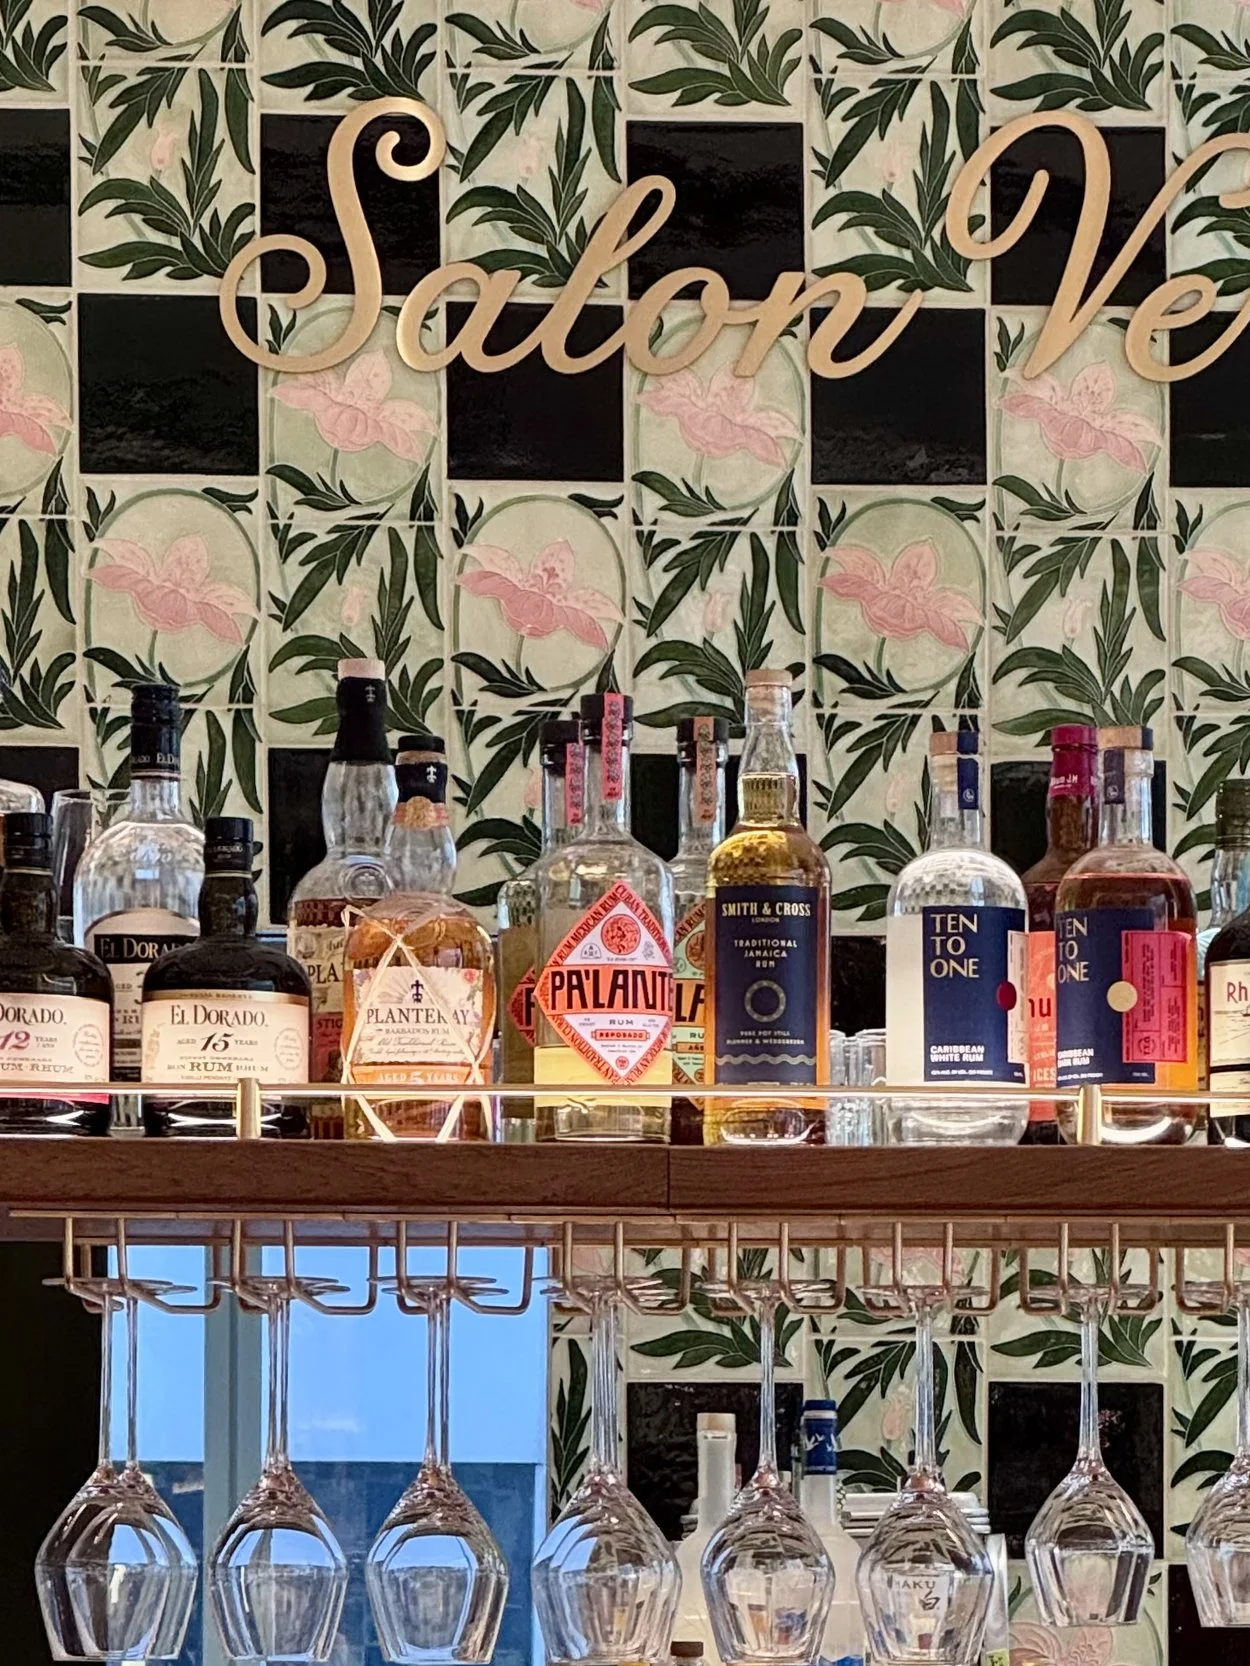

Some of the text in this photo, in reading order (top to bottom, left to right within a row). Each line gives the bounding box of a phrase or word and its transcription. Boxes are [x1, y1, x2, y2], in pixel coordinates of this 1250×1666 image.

[218, 95, 924, 378] Salon
[615, 884, 641, 913] CUBAN
[572, 908, 603, 945] MEXICAN
[599, 891, 621, 914] RUM
[721, 901, 811, 917] SMITH & CROSS
[930, 913, 978, 934] TEN
[1058, 917, 1088, 938] TEN
[101, 938, 182, 958] EL DORA
[734, 938, 797, 948] TRADITIONAL
[930, 936, 966, 956] TO
[1058, 940, 1079, 960] TO
[744, 949, 787, 958] JAMAICA
[755, 959, 775, 968] RUM
[930, 958, 980, 978] ONE
[1057, 961, 1090, 984] ONE
[171, 1004, 265, 1027] EL DORADO
[0, 1030, 31, 1051] 12
[201, 1032, 234, 1052] 15
[930, 1045, 985, 1054] CARIBBEAN
[189, 1062, 233, 1072] RUM
[930, 1053, 984, 1062] WHITE RUM
[919, 1590, 940, 1611] 白
